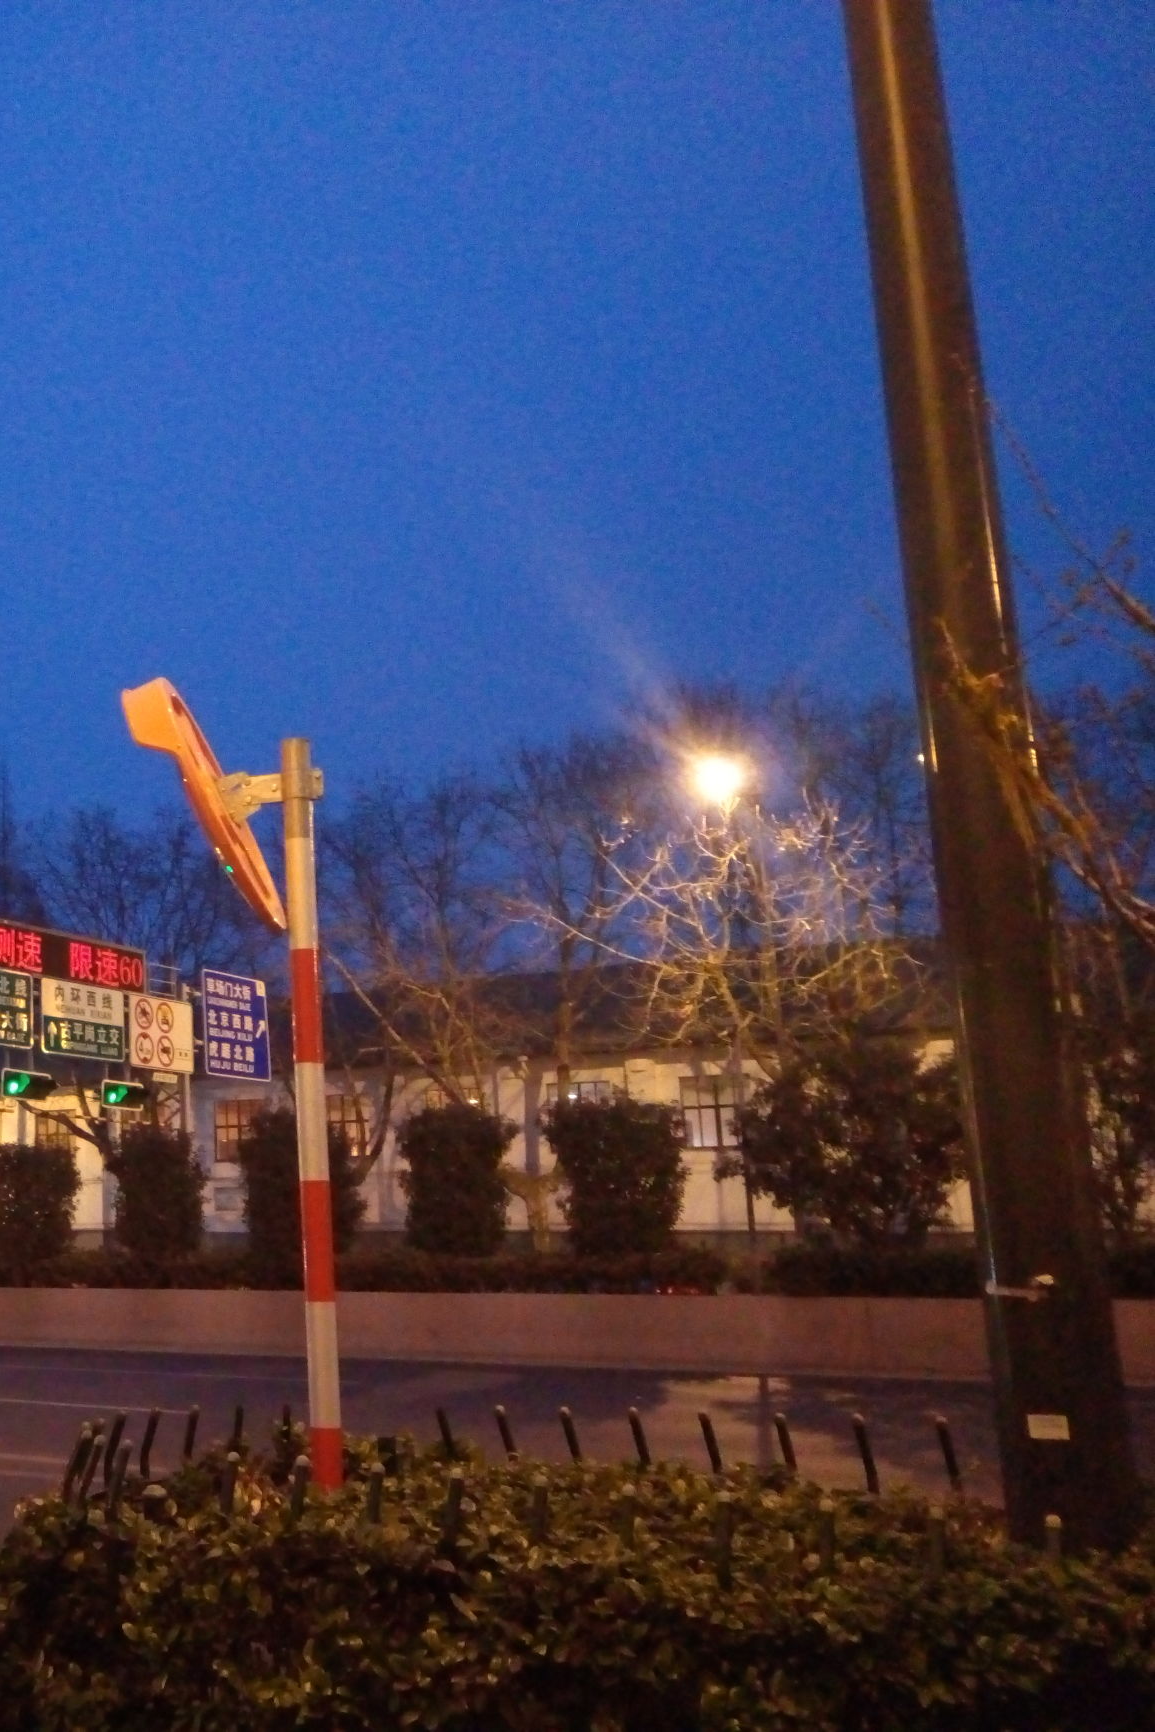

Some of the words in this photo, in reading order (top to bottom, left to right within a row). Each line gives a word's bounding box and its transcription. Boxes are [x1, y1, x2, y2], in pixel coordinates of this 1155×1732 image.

[69, 941, 143, 988] 限速60
[54, 984, 113, 1010] 内环西线
[206, 977, 252, 1001] 草场门大街
[207, 1008, 254, 1031] 北京西路
